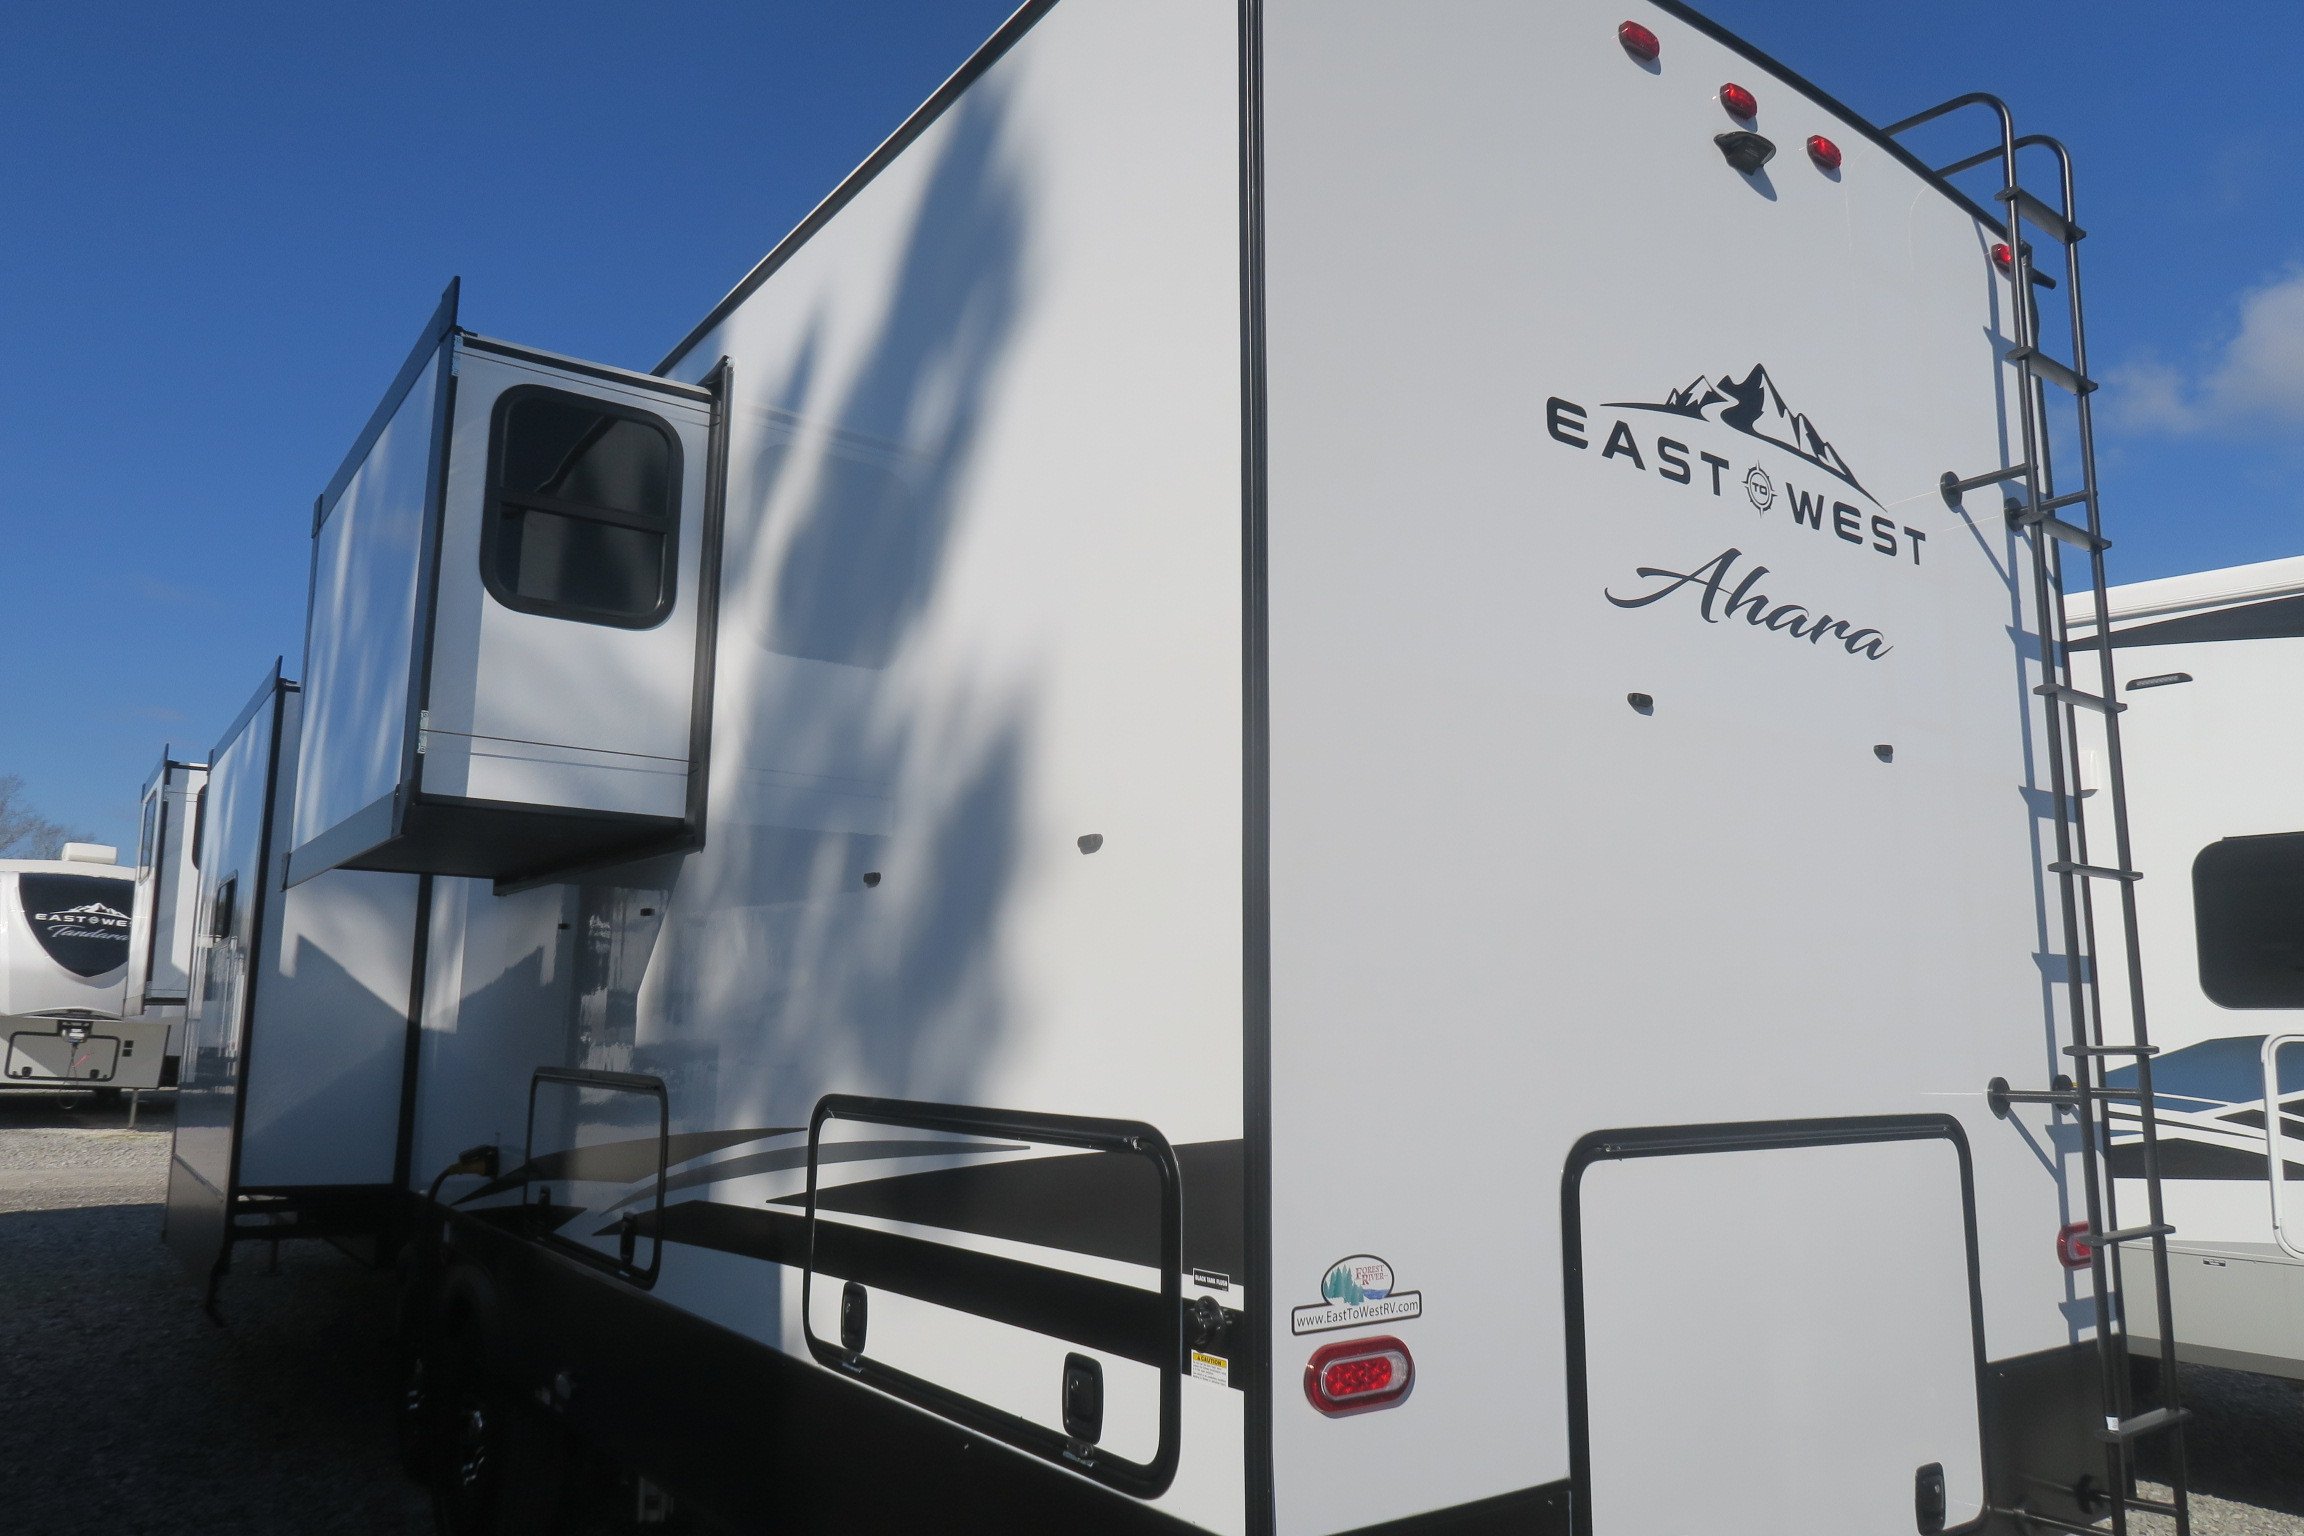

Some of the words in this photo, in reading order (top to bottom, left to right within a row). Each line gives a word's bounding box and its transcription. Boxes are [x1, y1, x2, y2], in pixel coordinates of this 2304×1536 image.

[1546, 396, 1730, 496] EAST
[1751, 481, 1768, 496] TO
[1785, 482, 1926, 566] WEST
[1604, 547, 1894, 661] Ahara
[35, 913, 86, 923] EAST
[102, 918, 131, 927] WE
[1355, 1264, 1385, 1280] FOREST
[1361, 1272, 1385, 1286] RIVER
[1296, 1300, 1419, 1328] www.EastToWestRV.com
[1200, 1355, 1223, 1367] CAUTION
